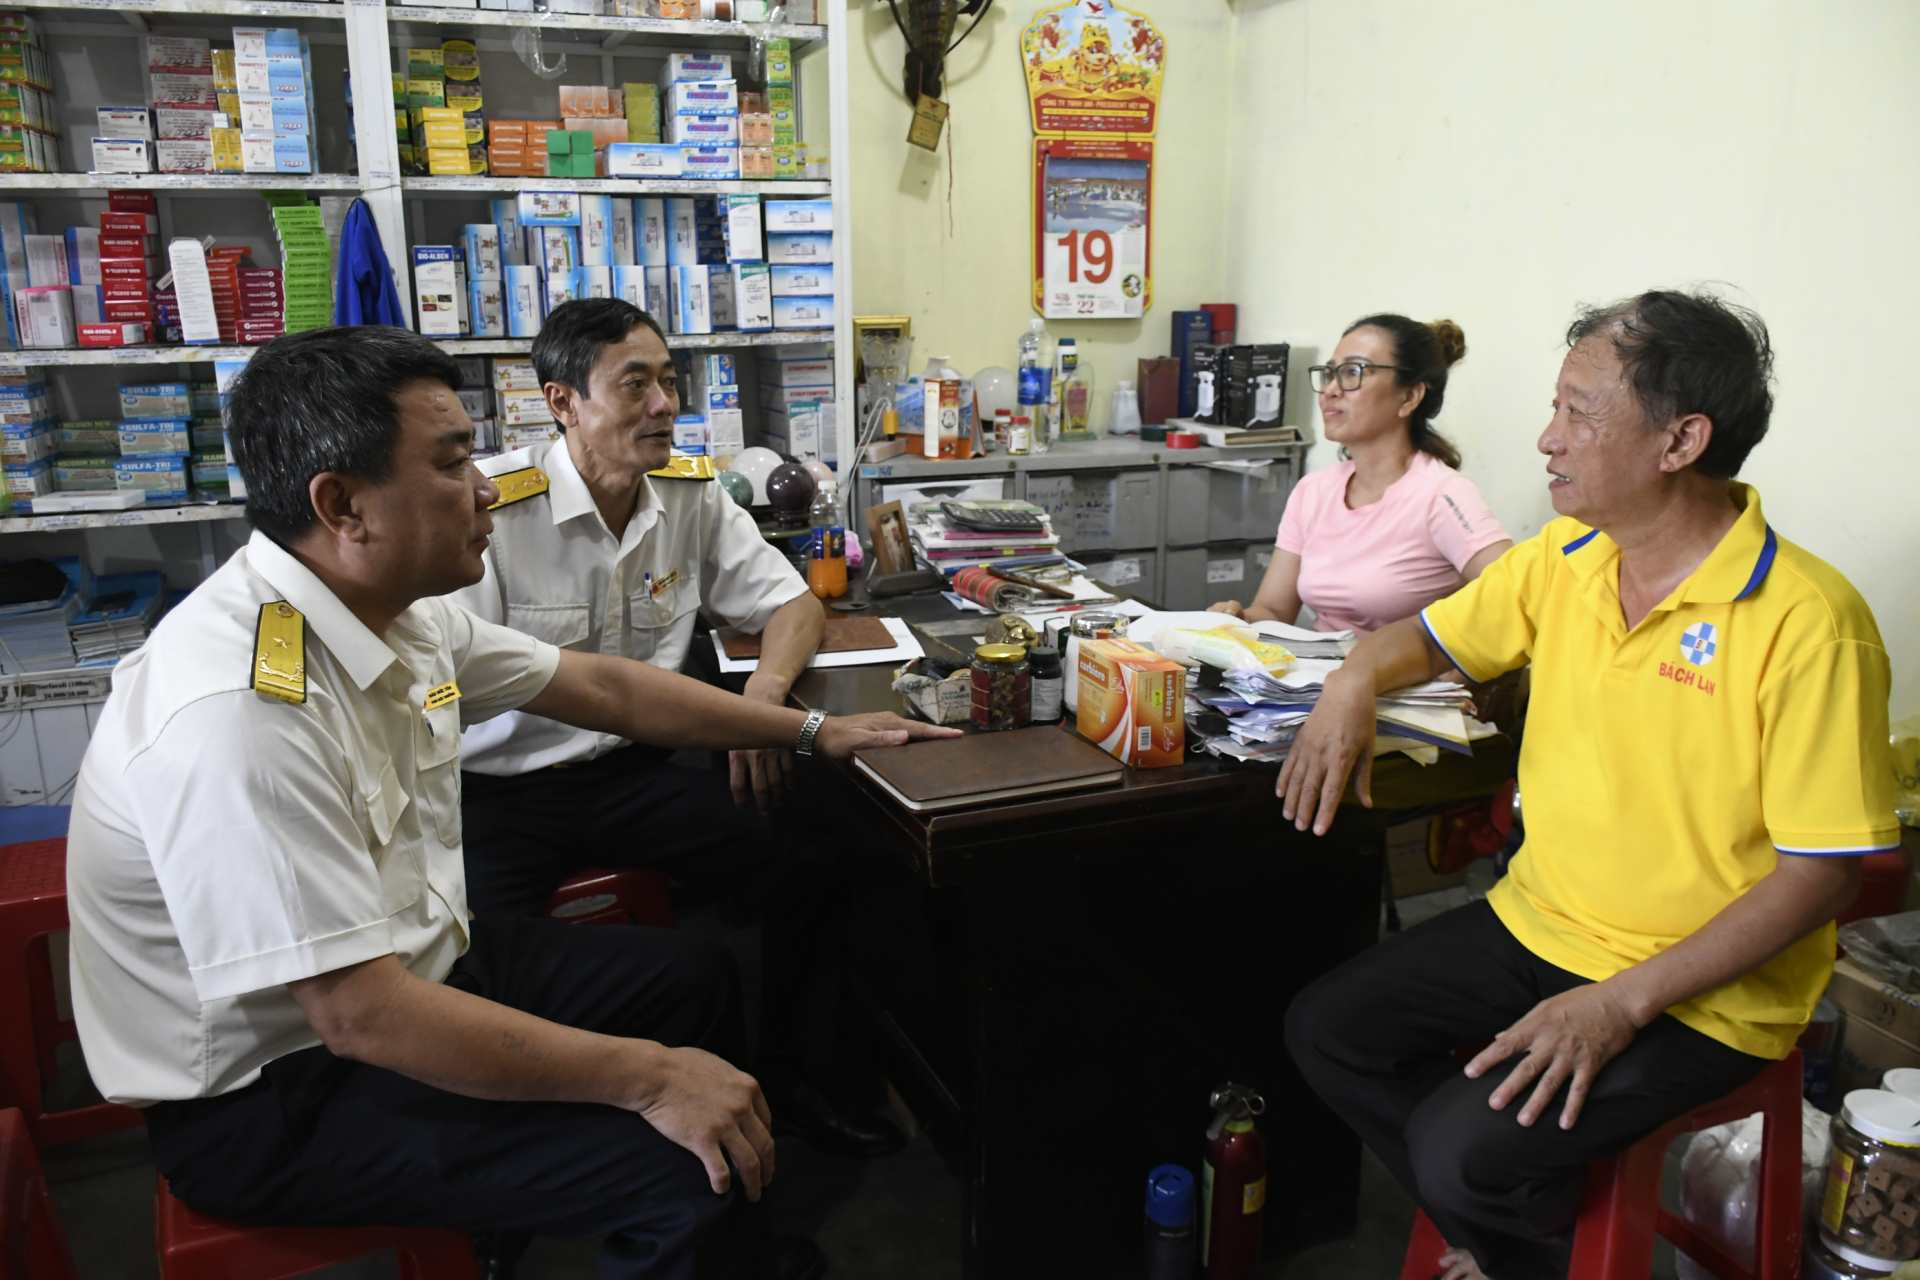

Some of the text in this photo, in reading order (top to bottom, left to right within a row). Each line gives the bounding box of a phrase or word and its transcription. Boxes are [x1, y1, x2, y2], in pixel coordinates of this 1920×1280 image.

[1058, 229, 1113, 284] 19
[1077, 300, 1094, 313] 22
[127, 386, 175, 394] SULFA-TRI
[126, 423, 174, 431] SULFA-TRI
[121, 462, 170, 471] SULFA-TRI
[1659, 661, 1695, 686] BÁCH
